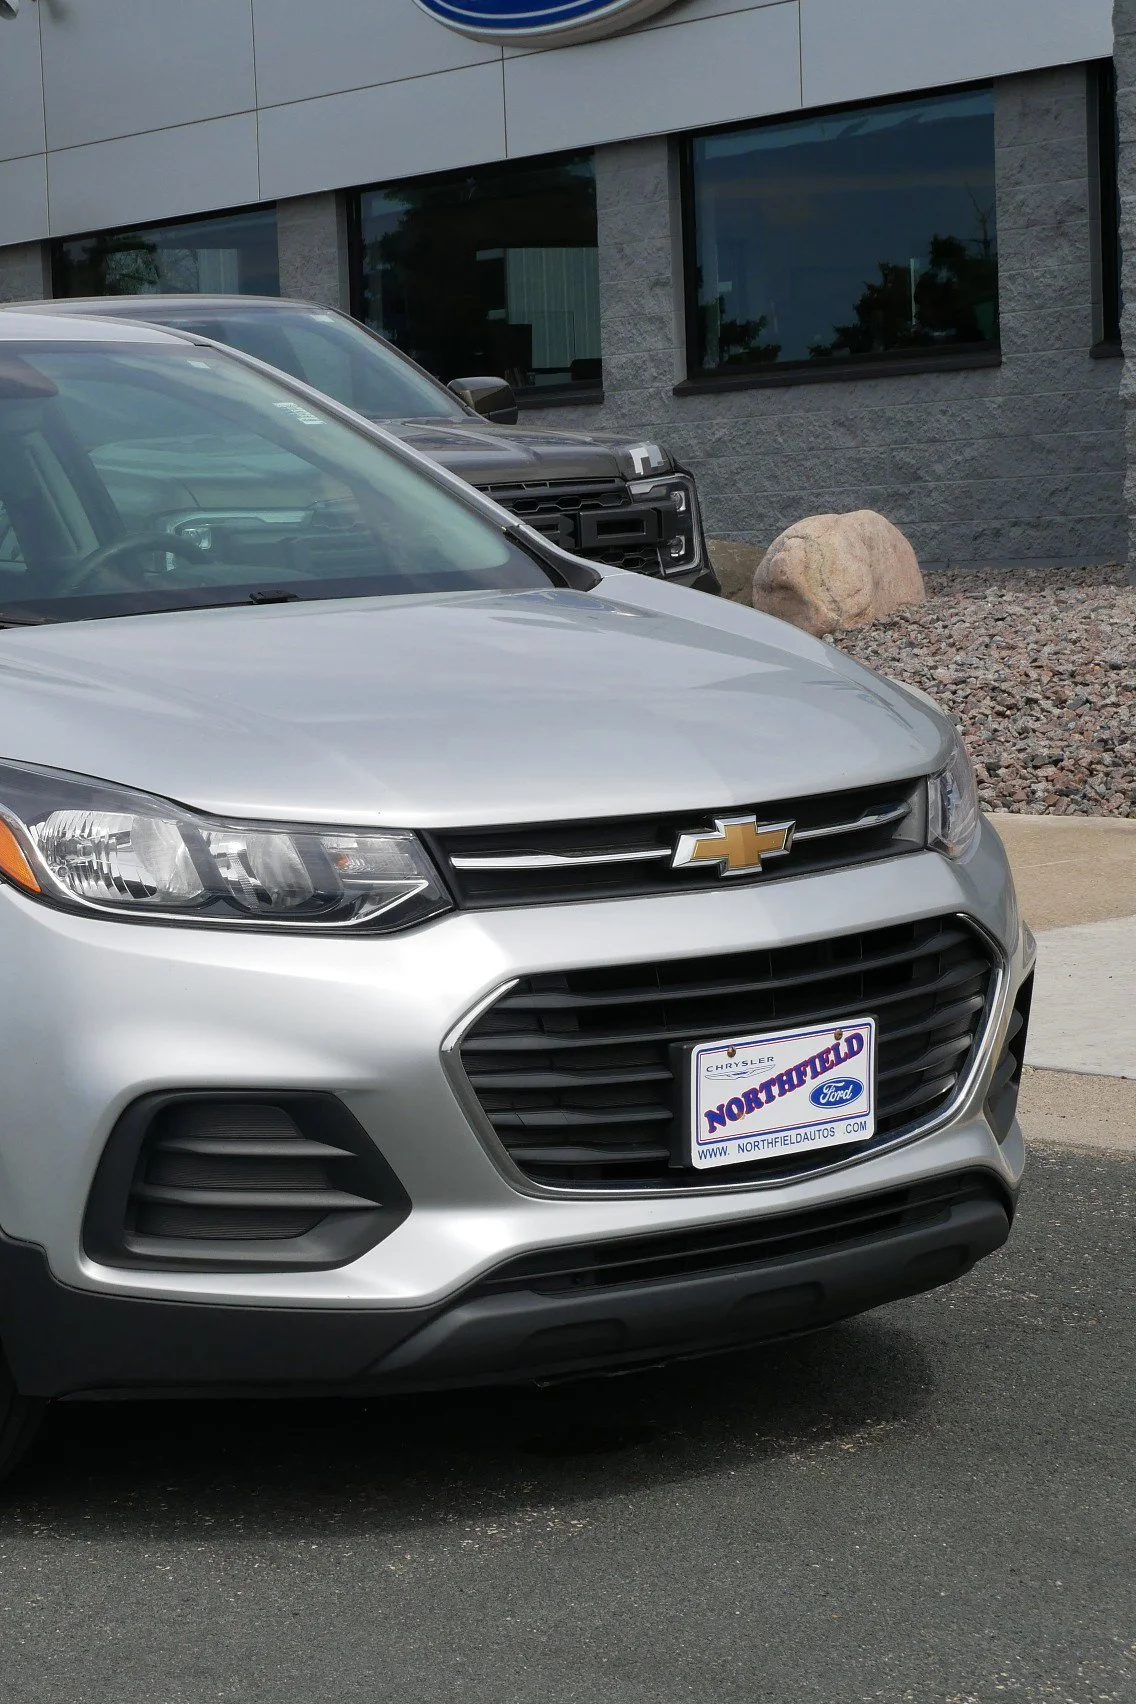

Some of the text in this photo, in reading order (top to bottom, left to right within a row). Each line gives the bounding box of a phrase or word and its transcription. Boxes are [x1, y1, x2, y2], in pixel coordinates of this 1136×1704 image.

[706, 1056, 774, 1072] CHRYSLER
[704, 1032, 863, 1133] NORTHFIELD
[819, 1082, 852, 1103] Ford
[737, 1127, 836, 1154] NORTHFIELDAUTOS
